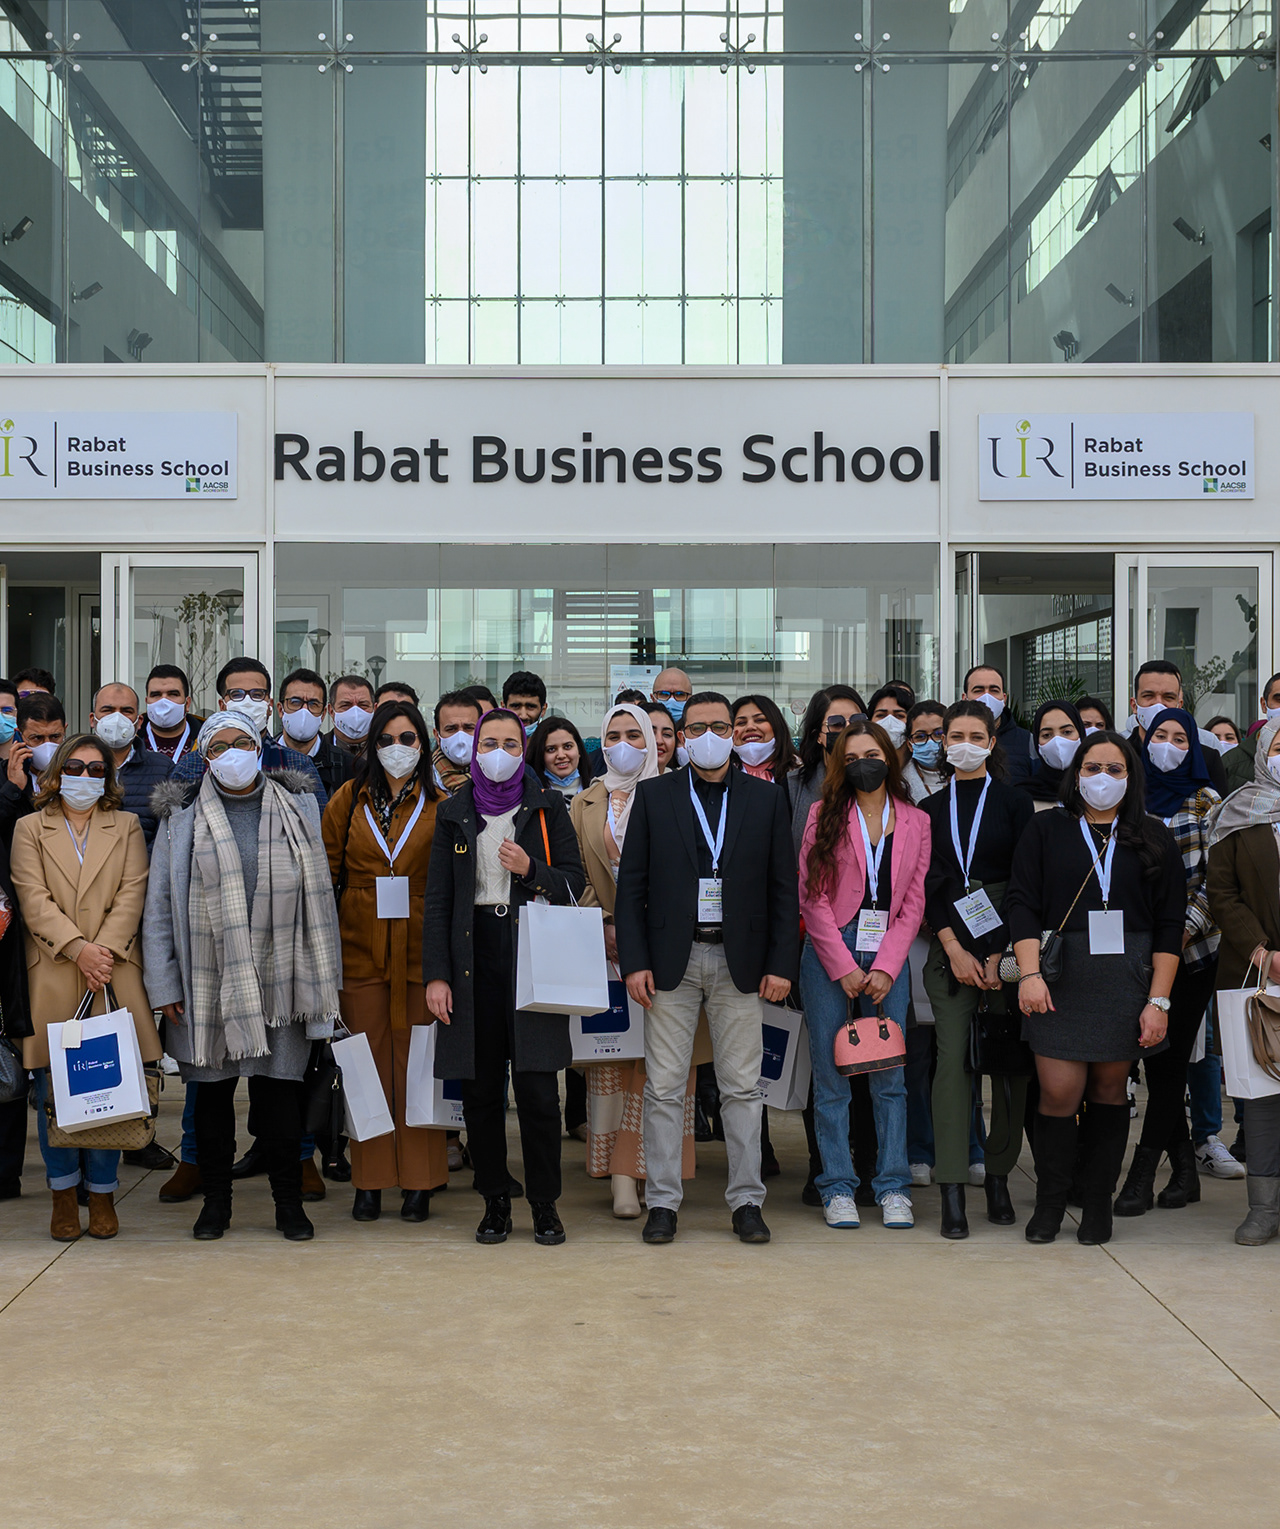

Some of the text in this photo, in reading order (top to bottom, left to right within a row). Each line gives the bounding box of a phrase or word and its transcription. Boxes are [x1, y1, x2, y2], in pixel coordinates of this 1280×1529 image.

[67, 436, 126, 452] Rabat
[1084, 437, 1143, 453] Rabat
[274, 431, 940, 483] Rabat Business School
[987, 437, 1065, 478] UIR
[67, 460, 229, 476] Business School
[1084, 460, 1247, 477] Business School
